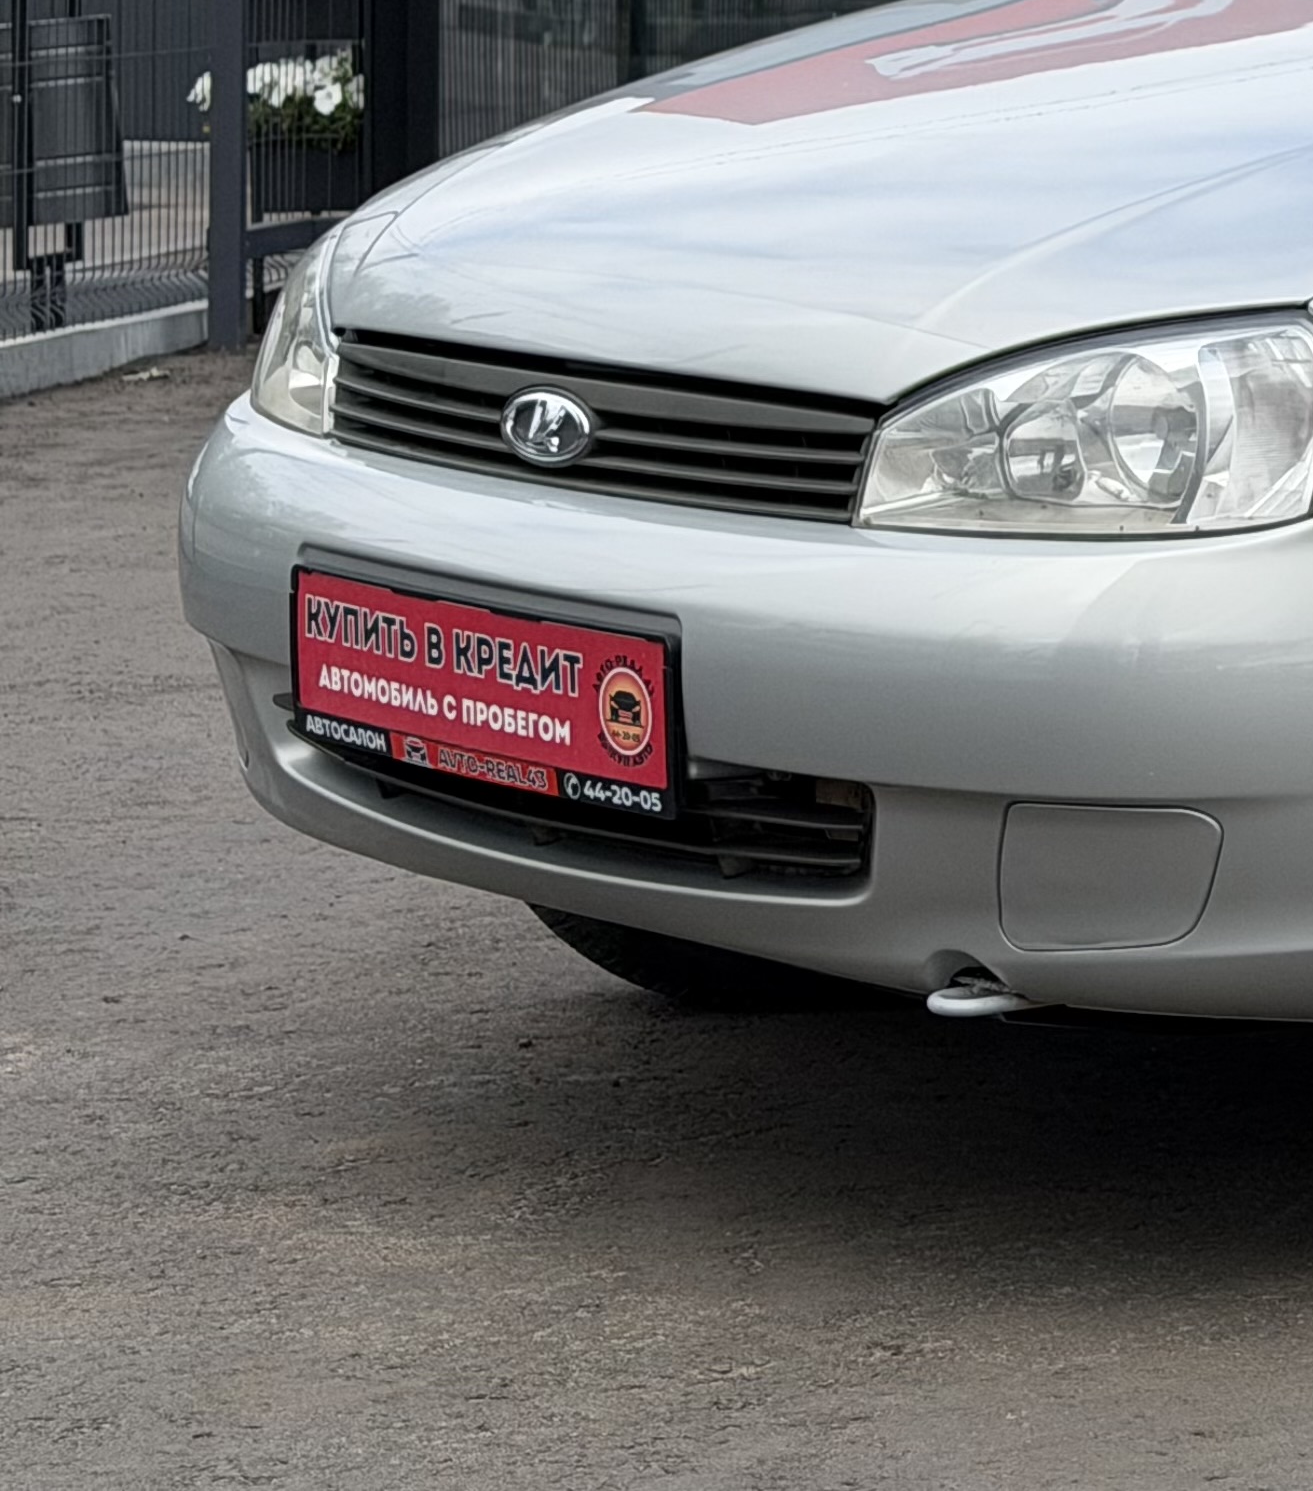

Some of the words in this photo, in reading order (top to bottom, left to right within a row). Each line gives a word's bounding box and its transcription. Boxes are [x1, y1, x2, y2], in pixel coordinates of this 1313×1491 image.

[304, 593, 418, 663] КУПИТЬ
[424, 622, 445, 669] В
[452, 628, 583, 697] КРЕДИТ
[318, 663, 438, 717] АВТОМОБИЛЬ
[442, 695, 457, 720] С
[461, 698, 571, 746] ПРОБЕГОМ
[306, 714, 387, 752] АВТОСАЛОН
[438, 748, 549, 791] AVTO-REAL43
[583, 780, 662, 812] 44-20-05
